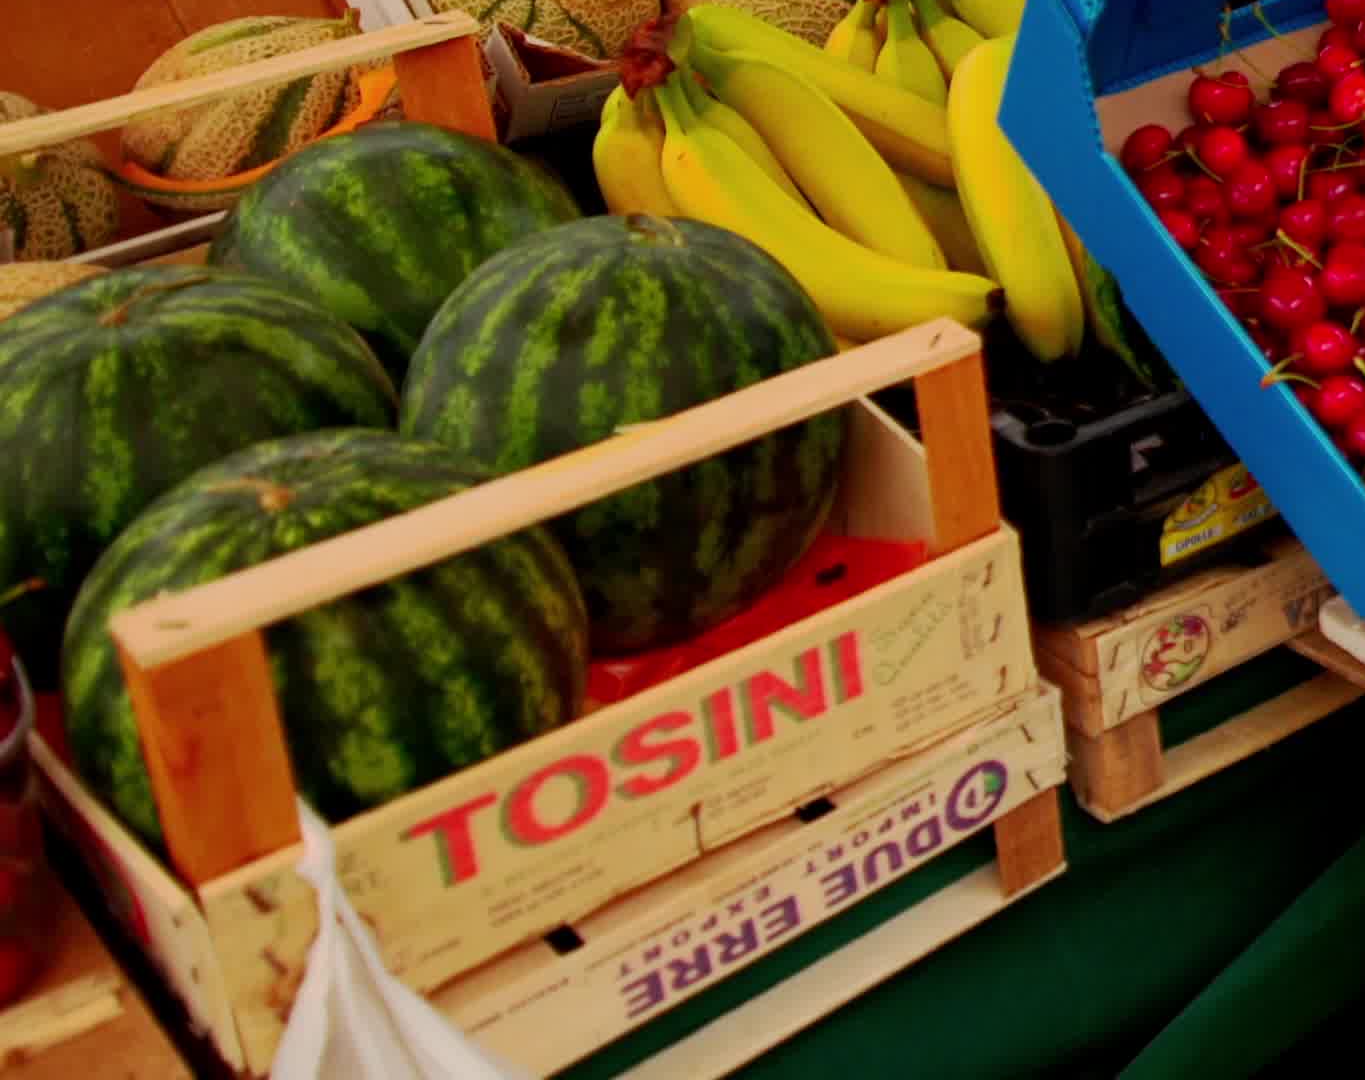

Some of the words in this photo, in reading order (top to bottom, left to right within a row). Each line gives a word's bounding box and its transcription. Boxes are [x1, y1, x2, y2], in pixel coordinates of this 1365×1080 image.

[397, 628, 866, 888] TOSINI
[804, 791, 937, 877] IMPORT
[818, 813, 943, 909] DUE
[619, 885, 772, 979] EXPORT
[620, 893, 802, 1020] ERRE
